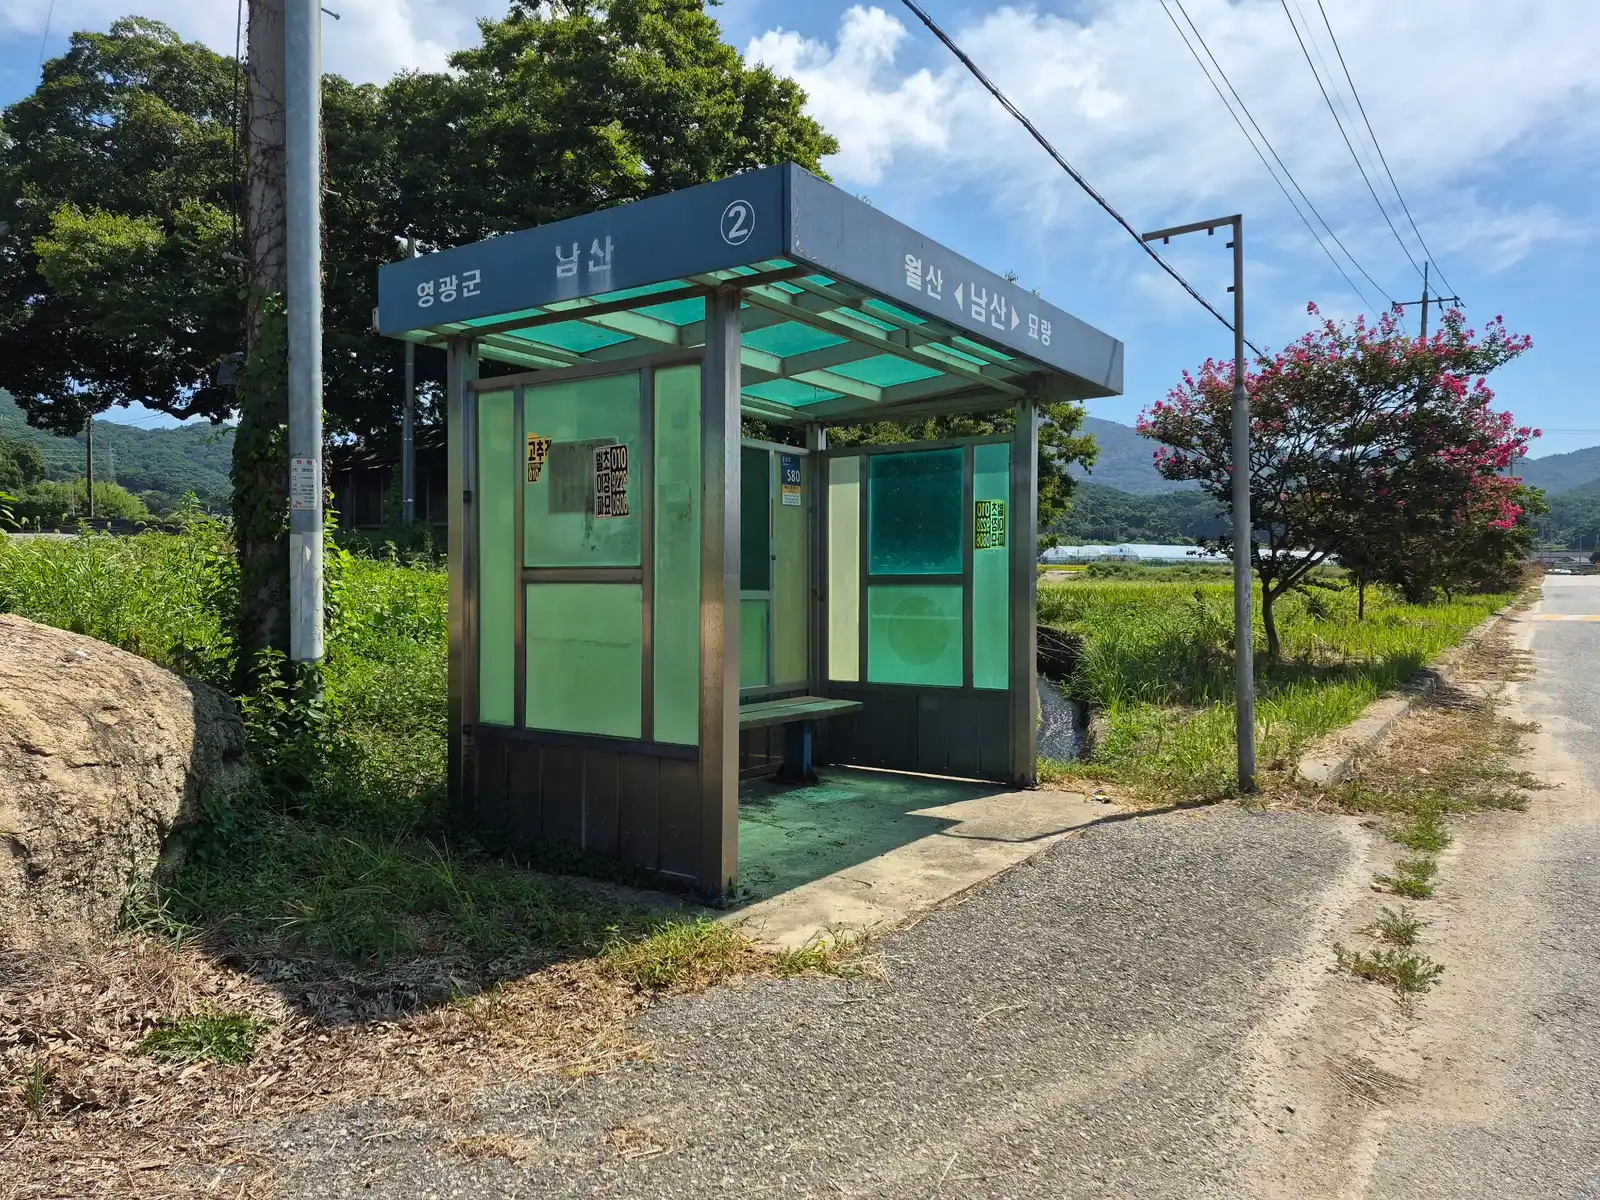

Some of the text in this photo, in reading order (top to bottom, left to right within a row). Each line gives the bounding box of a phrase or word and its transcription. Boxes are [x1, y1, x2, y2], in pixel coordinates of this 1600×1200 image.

[416, 269, 482, 308] 영광군
[556, 236, 614, 278] 남산
[905, 253, 943, 300] 월산
[970, 282, 1006, 331] 남산
[611, 447, 627, 470] 010
[787, 469, 801, 483] 580
